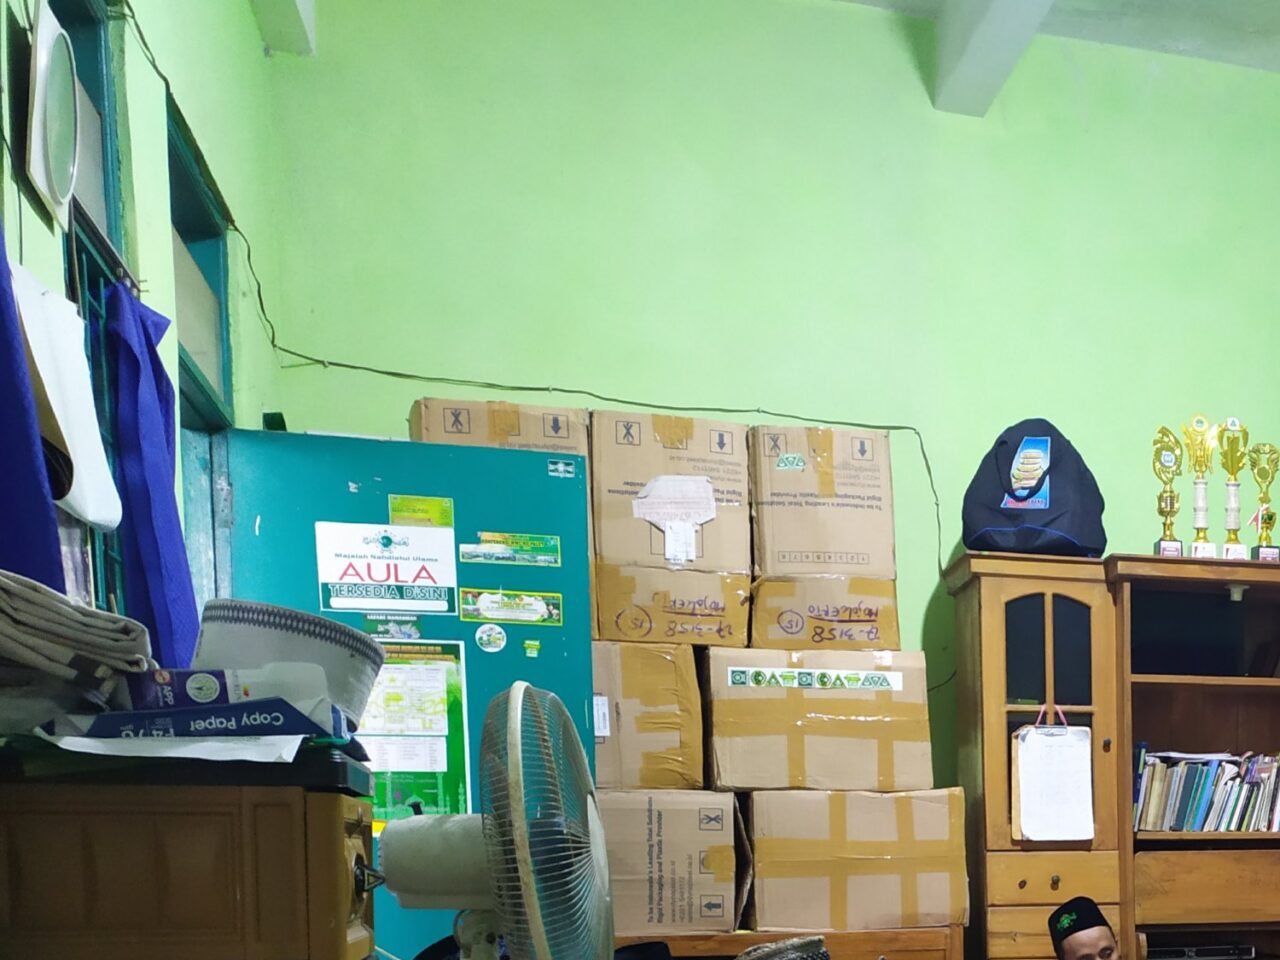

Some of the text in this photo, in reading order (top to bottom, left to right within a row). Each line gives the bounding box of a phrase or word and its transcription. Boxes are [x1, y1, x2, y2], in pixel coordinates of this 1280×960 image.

[334, 552, 368, 560] Majalah
[338, 561, 438, 585] AULA
[328, 583, 399, 598] TERSEDIA
[189, 715, 238, 731] Paper
[242, 712, 285, 729] Copy
